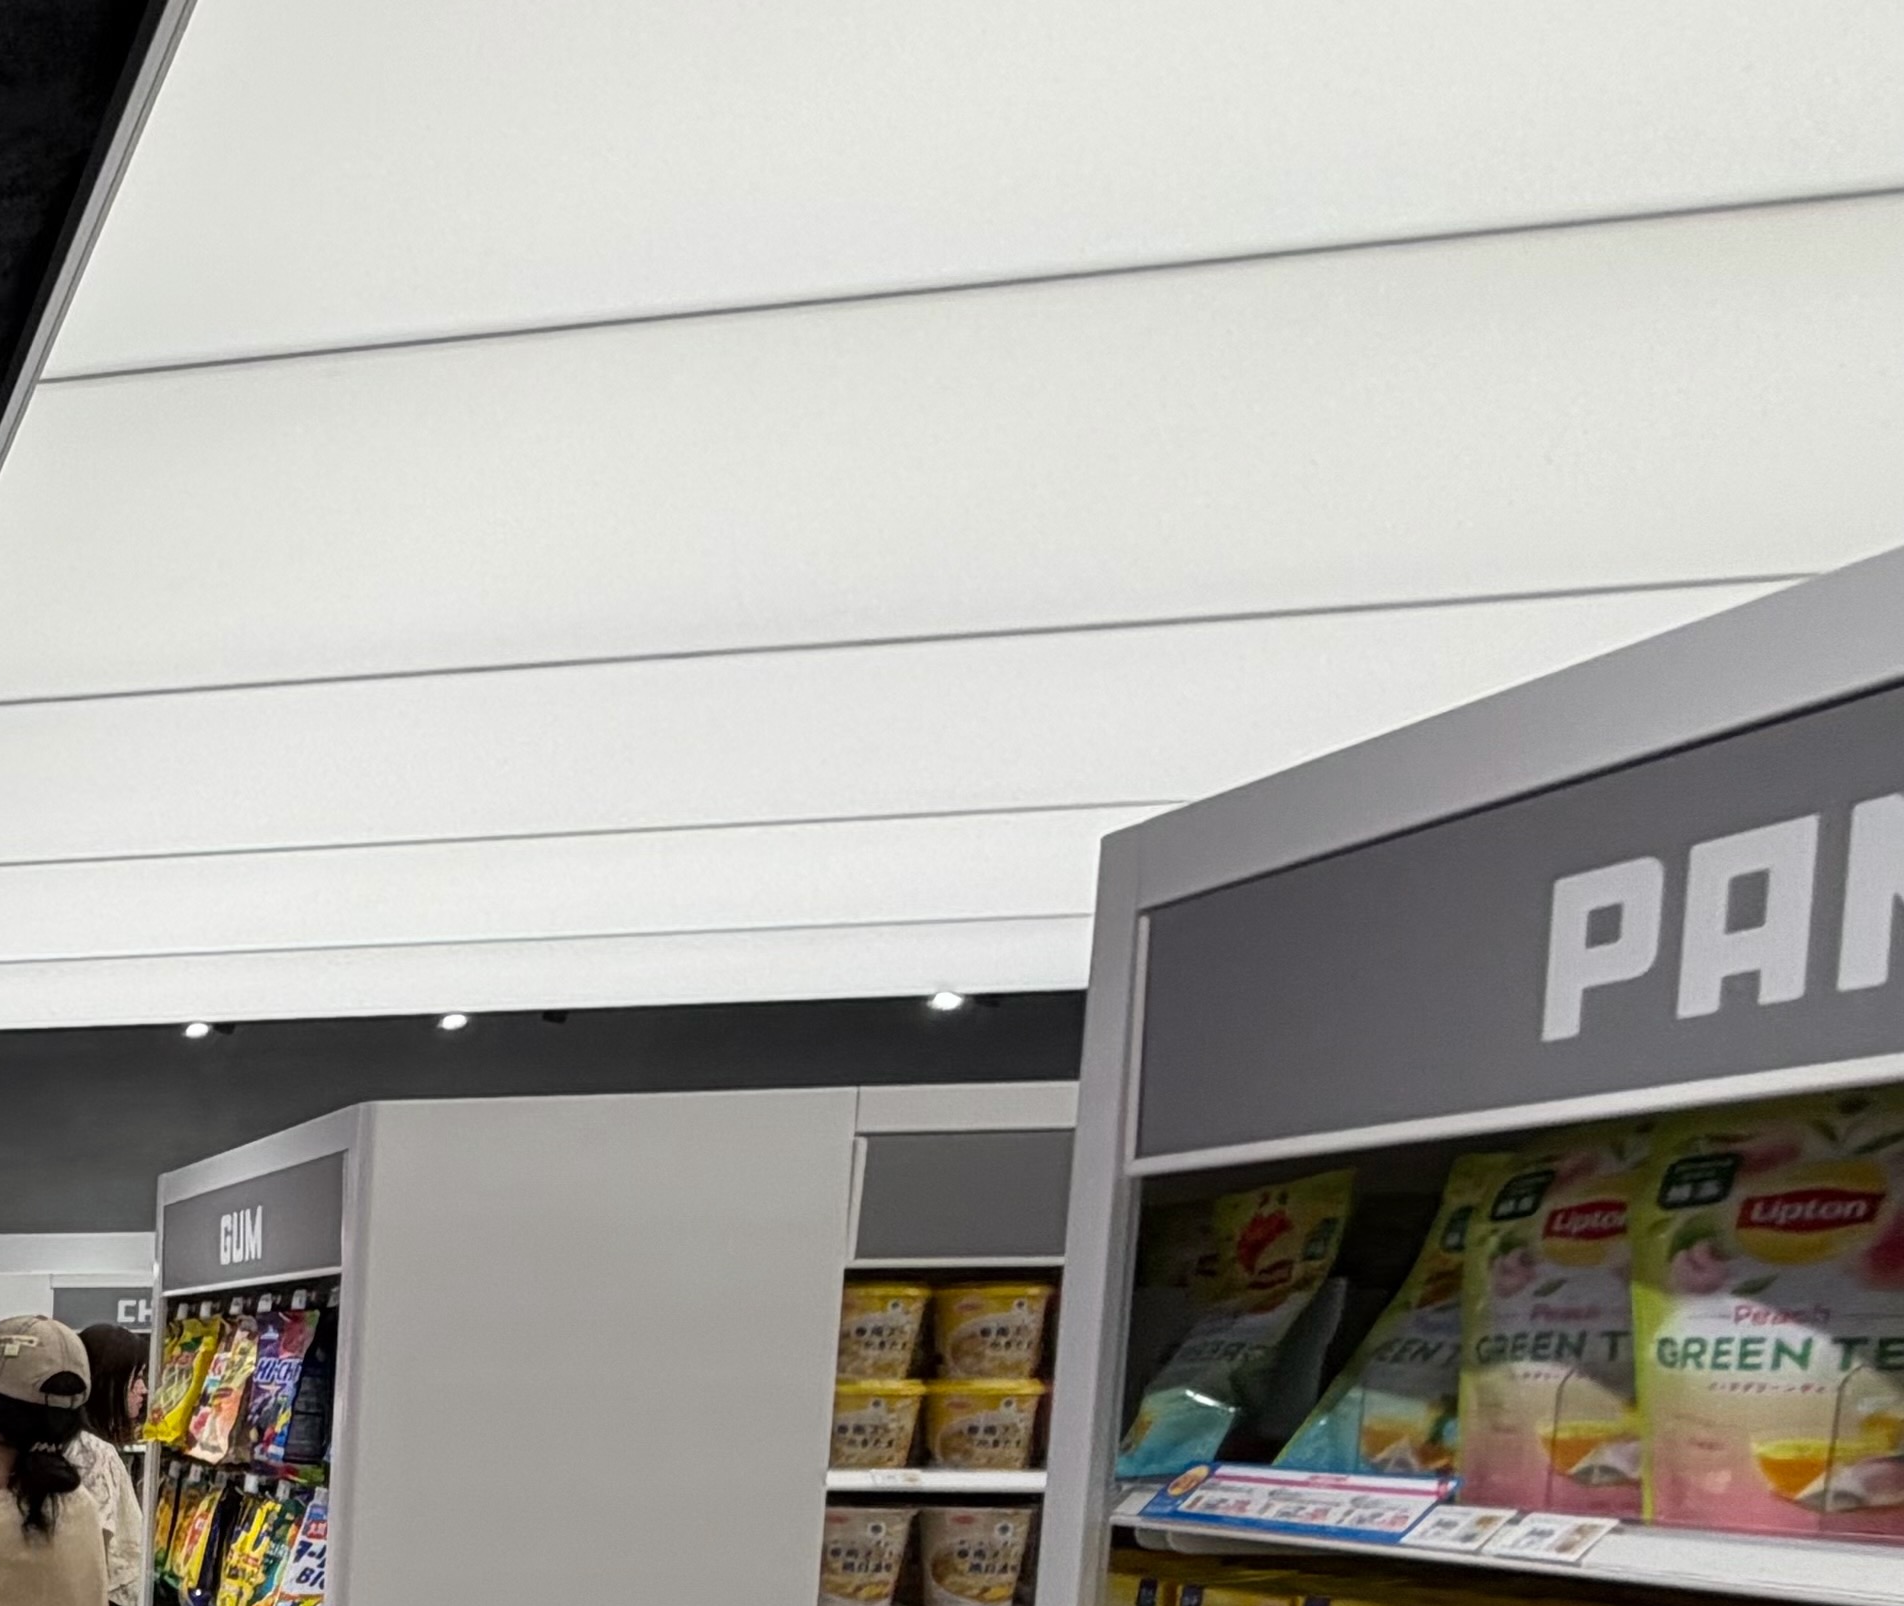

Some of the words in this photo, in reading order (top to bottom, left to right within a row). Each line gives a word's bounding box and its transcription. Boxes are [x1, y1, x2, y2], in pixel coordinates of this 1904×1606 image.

[1748, 1198, 1868, 1226] Lipton
[219, 1205, 263, 1266] GUM
[1475, 1329, 1588, 1367] GREEN
[1656, 1335, 1816, 1373] GREEN
